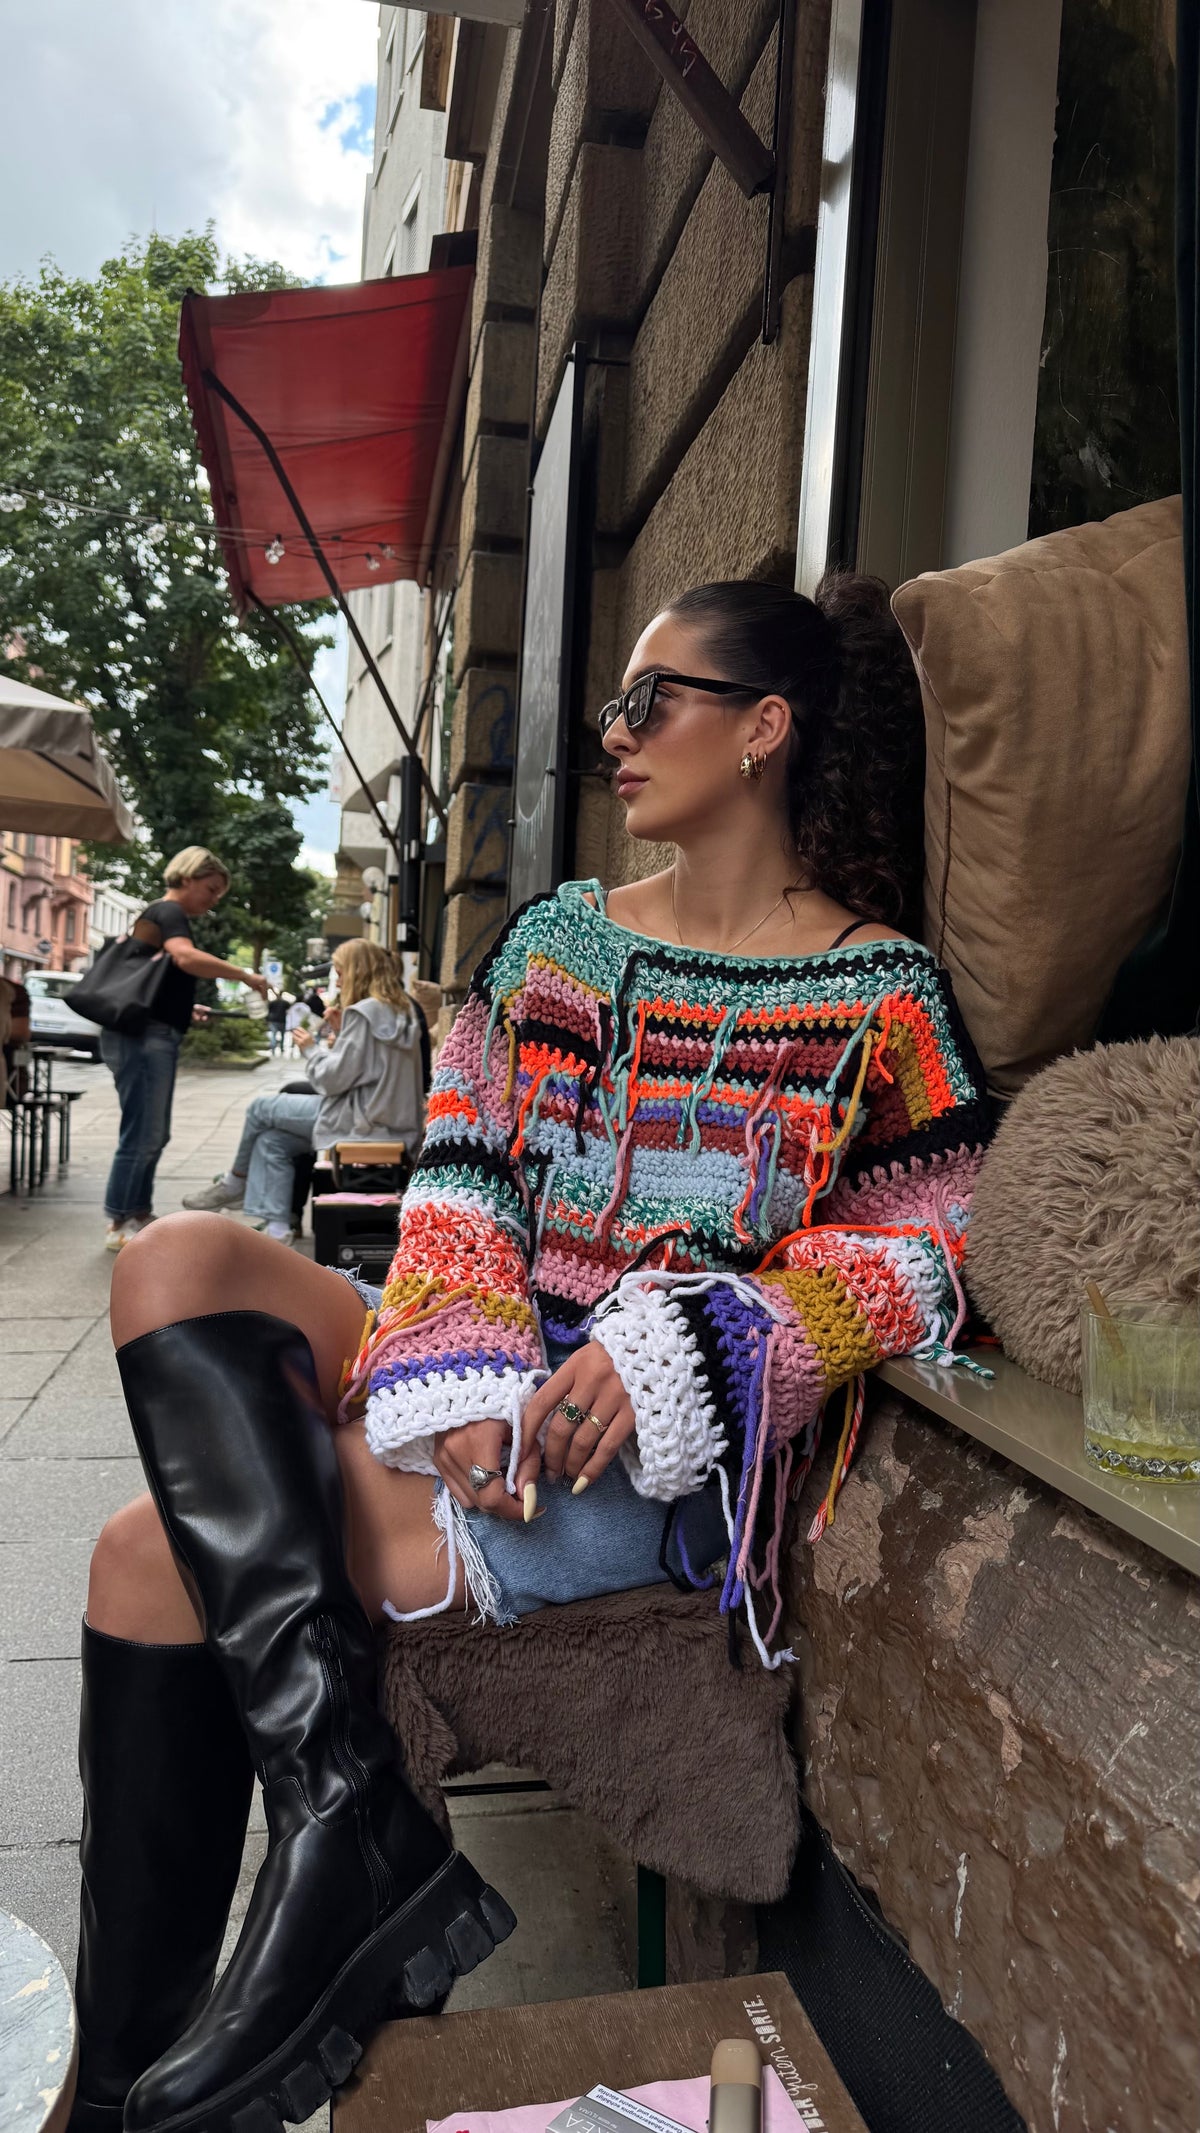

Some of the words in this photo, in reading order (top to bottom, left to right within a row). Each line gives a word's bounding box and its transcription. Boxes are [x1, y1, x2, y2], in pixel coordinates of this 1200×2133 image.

[743, 1995, 781, 2044] SORTE.
[770, 2046, 818, 2096] guten
[619, 2098, 637, 2110] macht
[636, 2108, 650, 2117] und
[793, 2097, 825, 2129] DER
